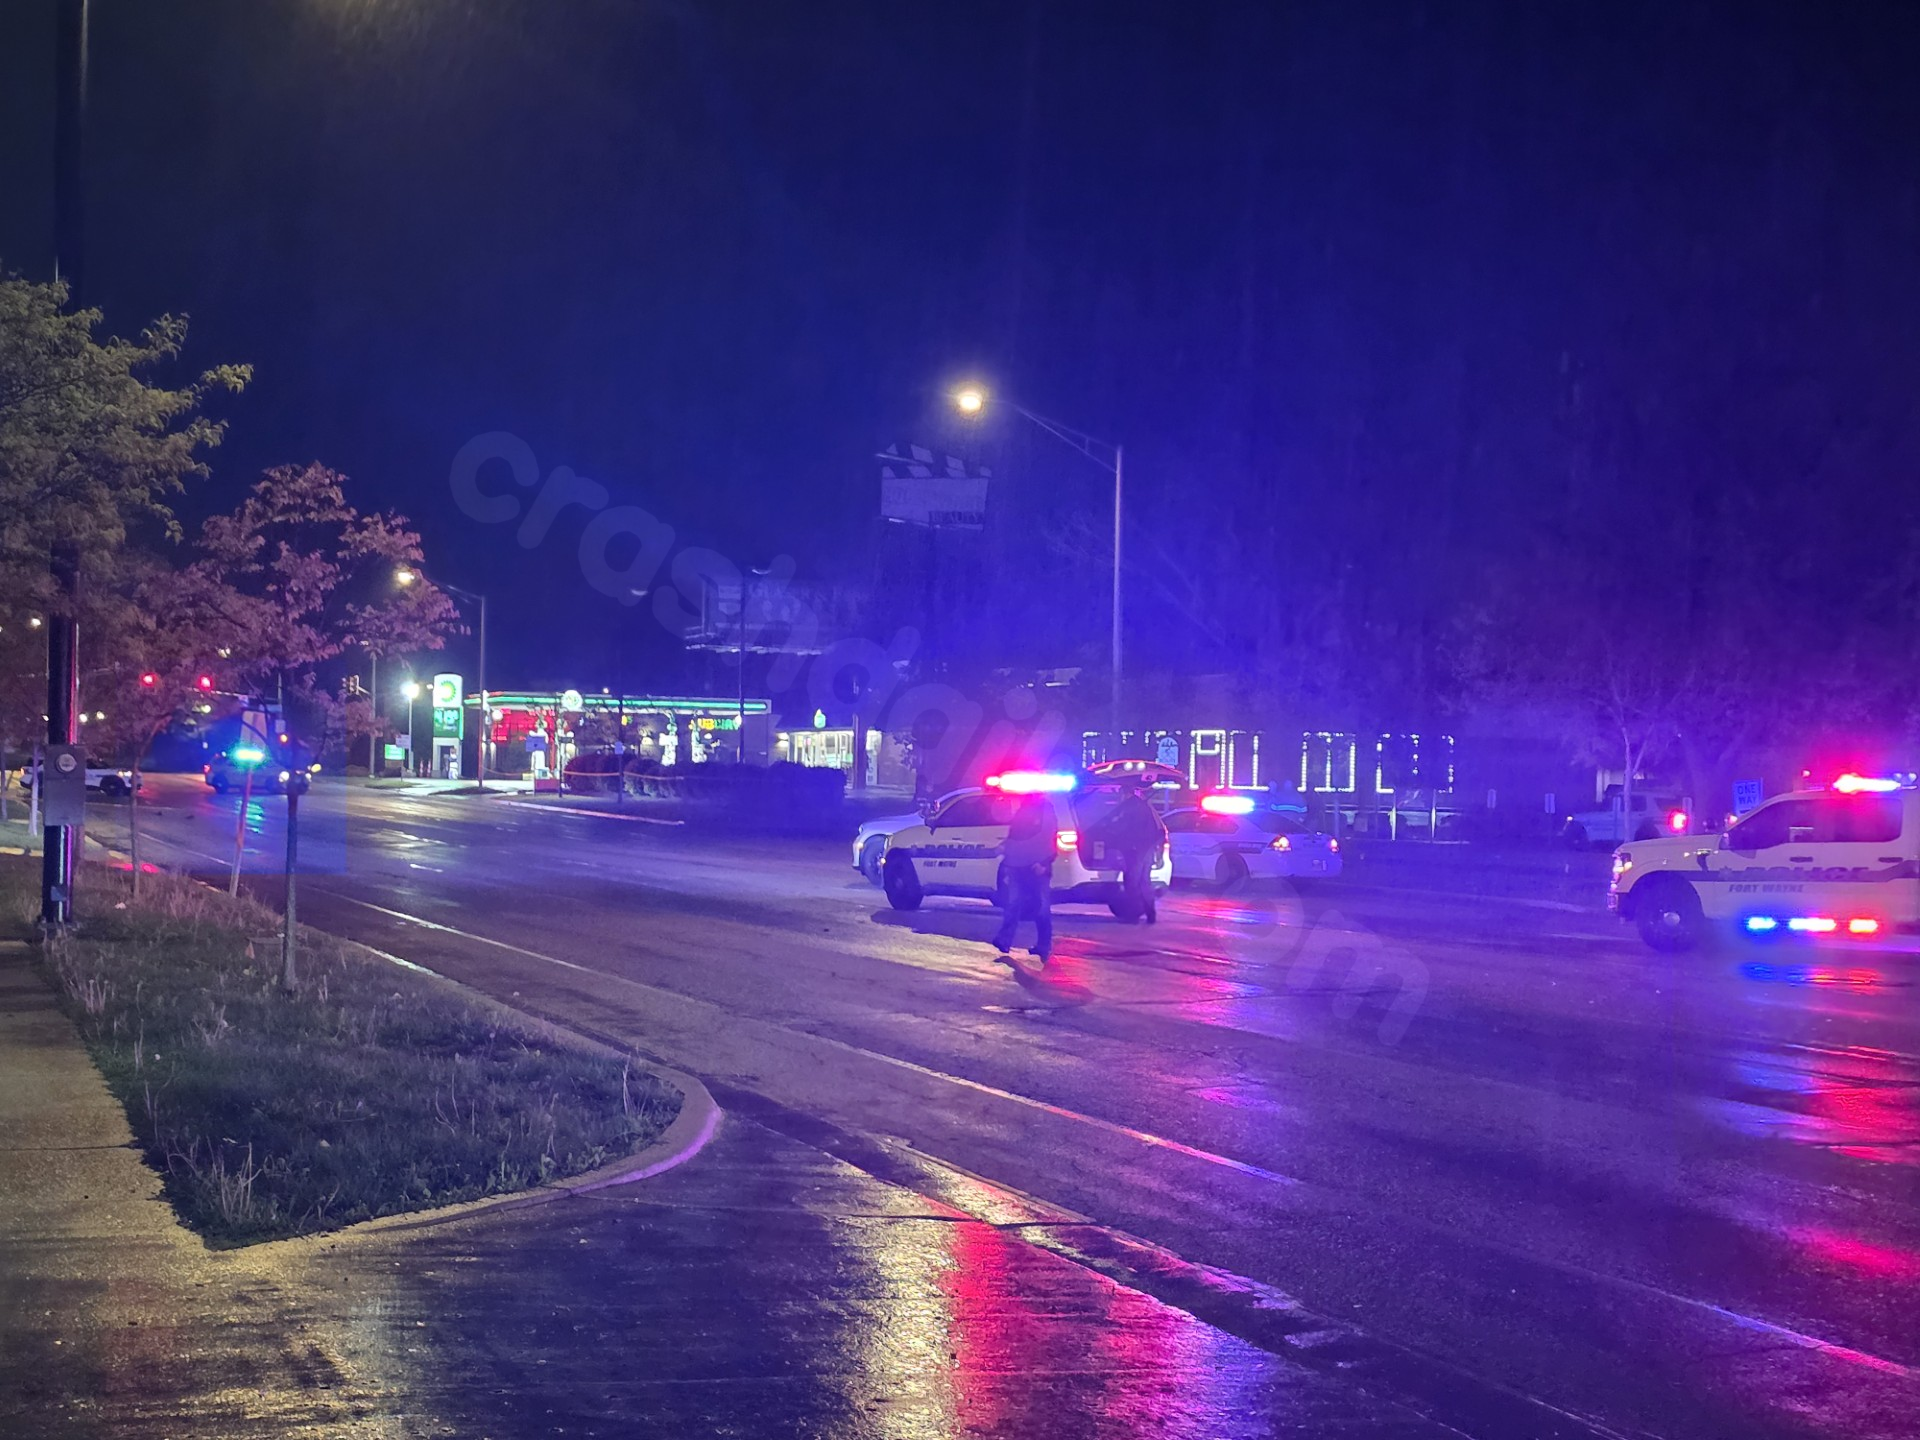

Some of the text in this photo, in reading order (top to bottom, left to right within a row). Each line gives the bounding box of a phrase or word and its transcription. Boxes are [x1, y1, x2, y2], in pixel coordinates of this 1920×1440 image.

[1737, 785, 1756, 795] ONE
[1738, 796, 1758, 806] WAY
[924, 843, 985, 855] POLICE
[1744, 866, 1869, 882] POLICE
[1728, 884, 1804, 893] FORT WAYNE
